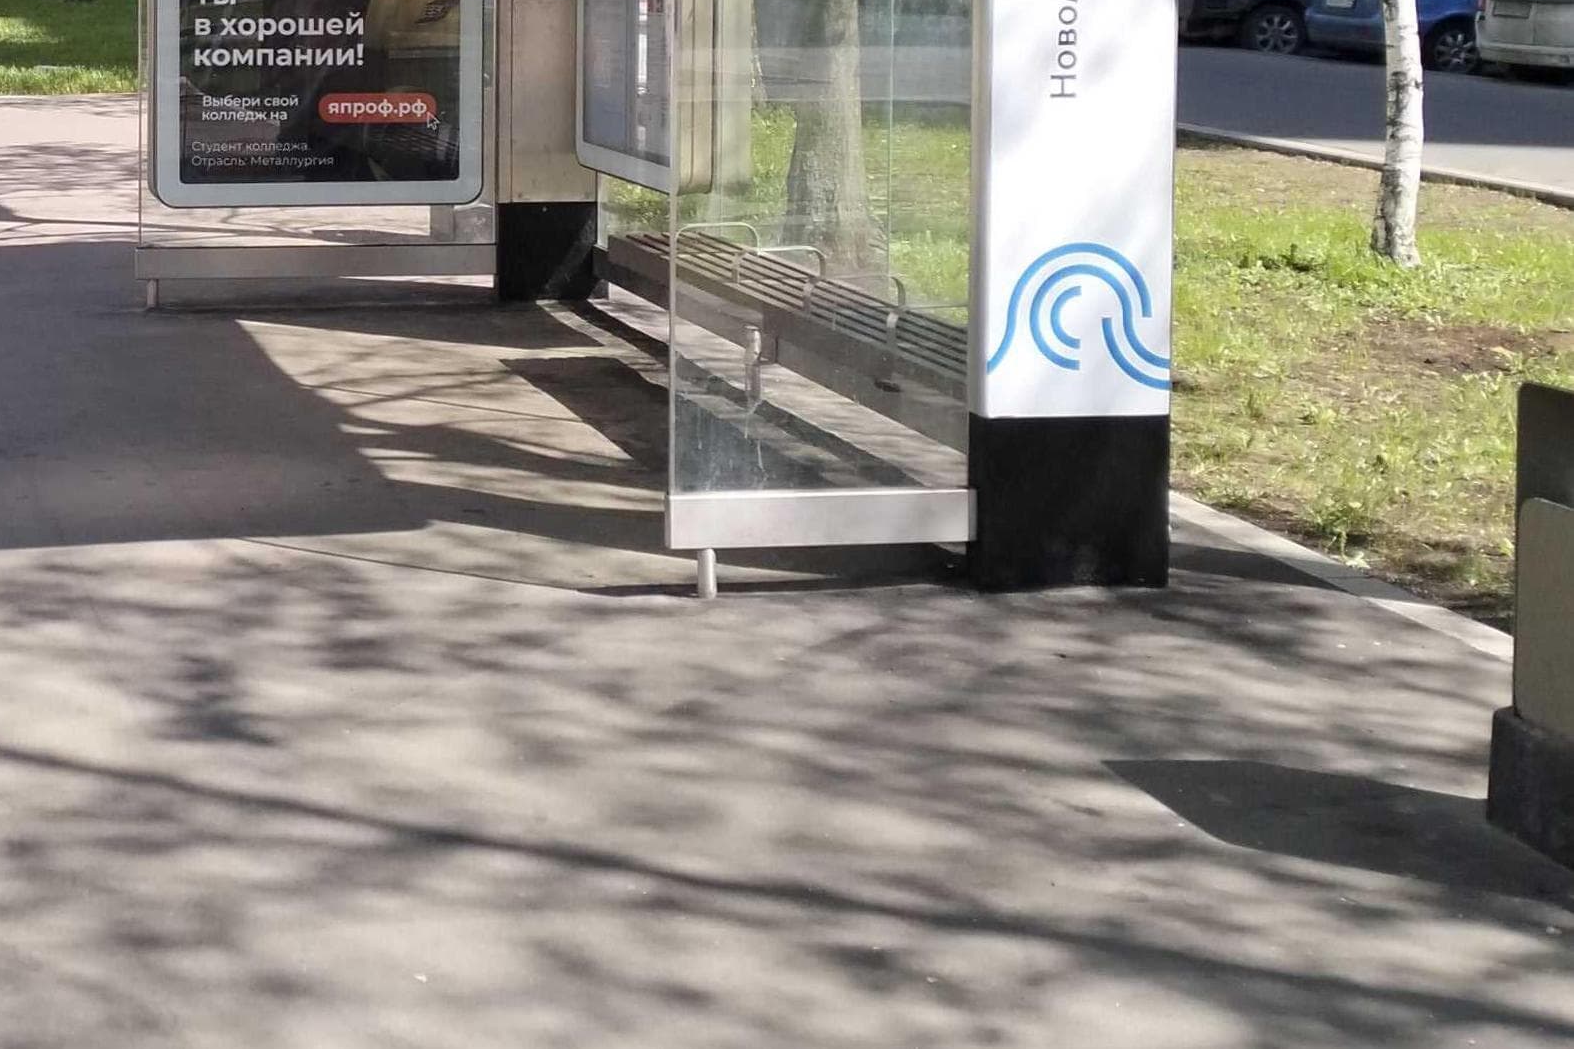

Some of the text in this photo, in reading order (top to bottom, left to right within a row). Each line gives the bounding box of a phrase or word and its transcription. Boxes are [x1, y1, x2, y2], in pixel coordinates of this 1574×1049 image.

[194, 11, 364, 42] в хорошей
[193, 43, 364, 67] компании!
[202, 94, 299, 110] Выбери свой
[328, 98, 427, 118] япроф.рф
[201, 110, 288, 122] колледж на
[191, 141, 243, 155] Студент
[250, 155, 335, 168] Металлургия
